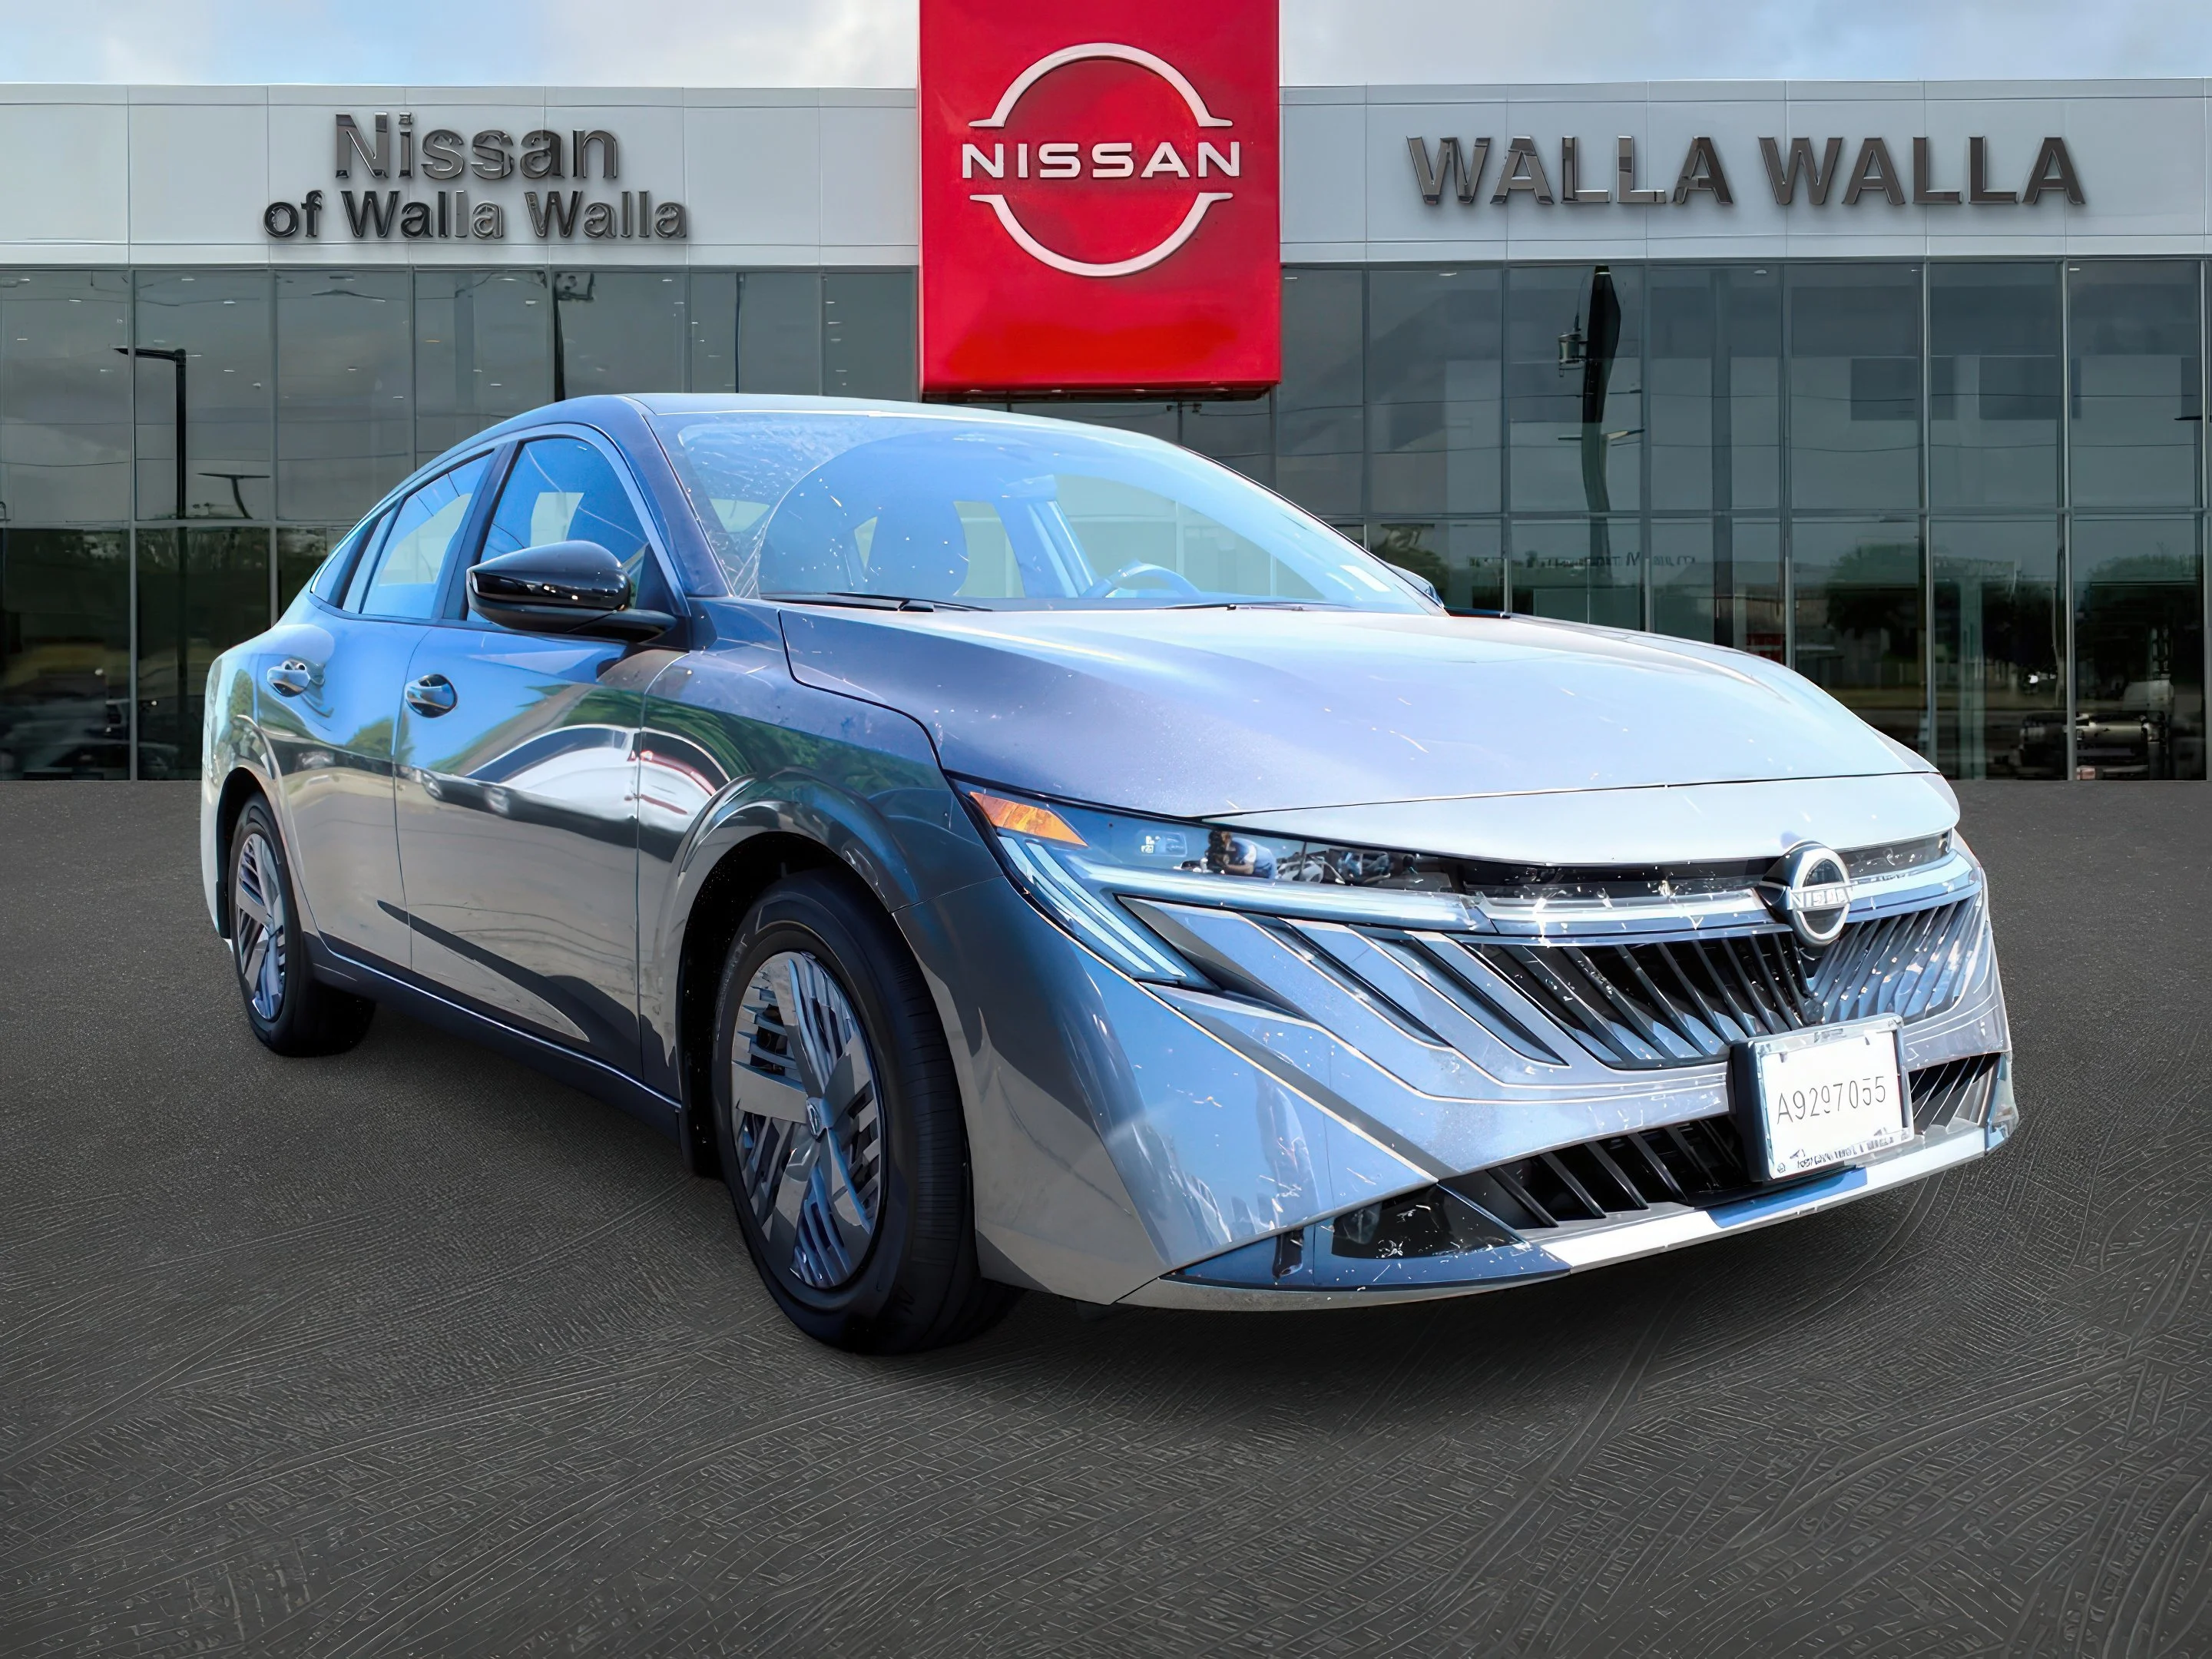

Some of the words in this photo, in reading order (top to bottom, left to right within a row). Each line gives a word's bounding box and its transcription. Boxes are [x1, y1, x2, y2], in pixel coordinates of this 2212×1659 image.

[335, 111, 619, 180] Nissan
[962, 141, 1240, 178] NISSAN
[1406, 135, 1734, 205] WALLA
[1758, 135, 2085, 205] WALLA
[263, 190, 323, 238] of
[340, 190, 504, 239] Walla
[524, 190, 687, 239] Walla
